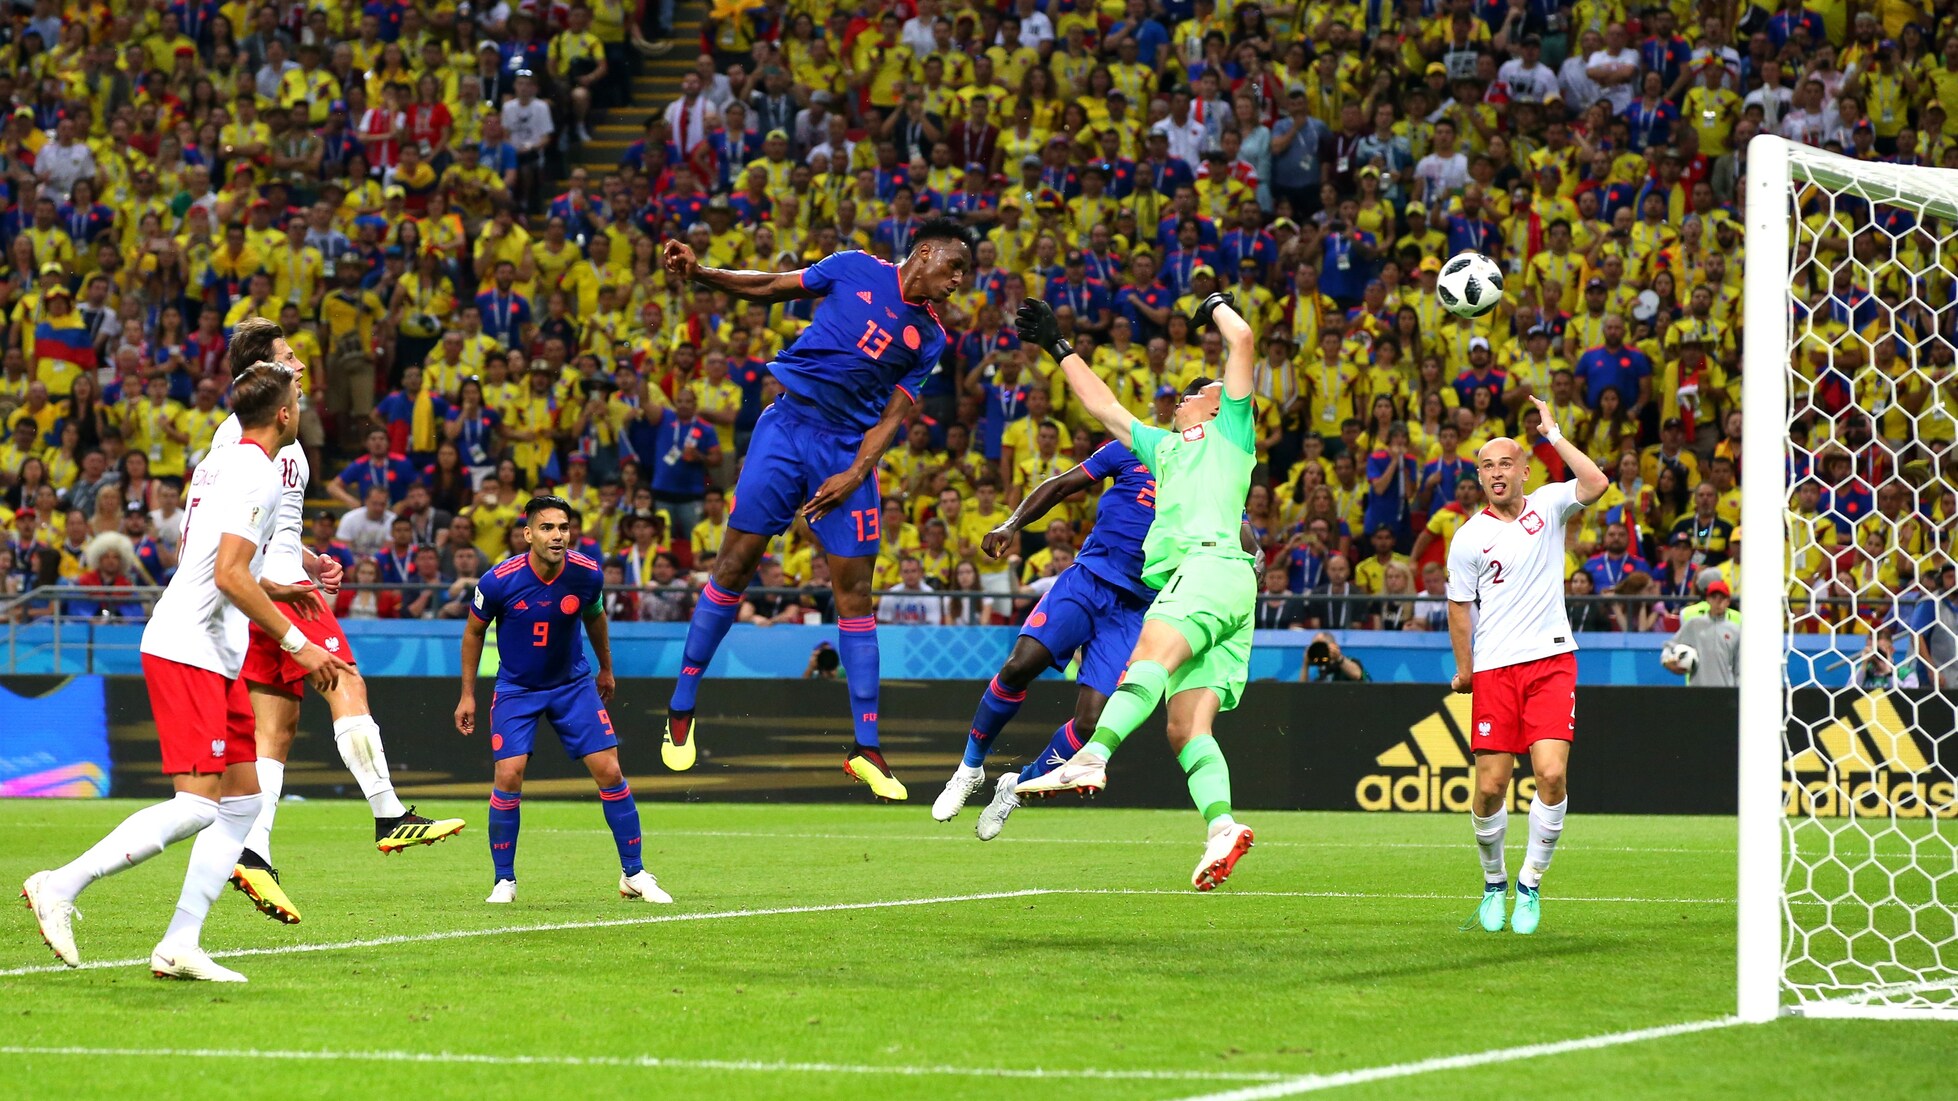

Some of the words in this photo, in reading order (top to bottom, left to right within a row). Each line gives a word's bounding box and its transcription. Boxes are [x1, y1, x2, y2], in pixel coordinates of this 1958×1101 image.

[856, 319, 893, 360] 13
[281, 457, 299, 488] 10
[1136, 479, 1156, 509] 2
[851, 507, 880, 542] 13
[1170, 575, 1184, 594] 1
[1489, 560, 1505, 585] 2
[532, 621, 549, 647] 9
[597, 709, 615, 736] 9
[1355, 764, 1537, 812] adids
